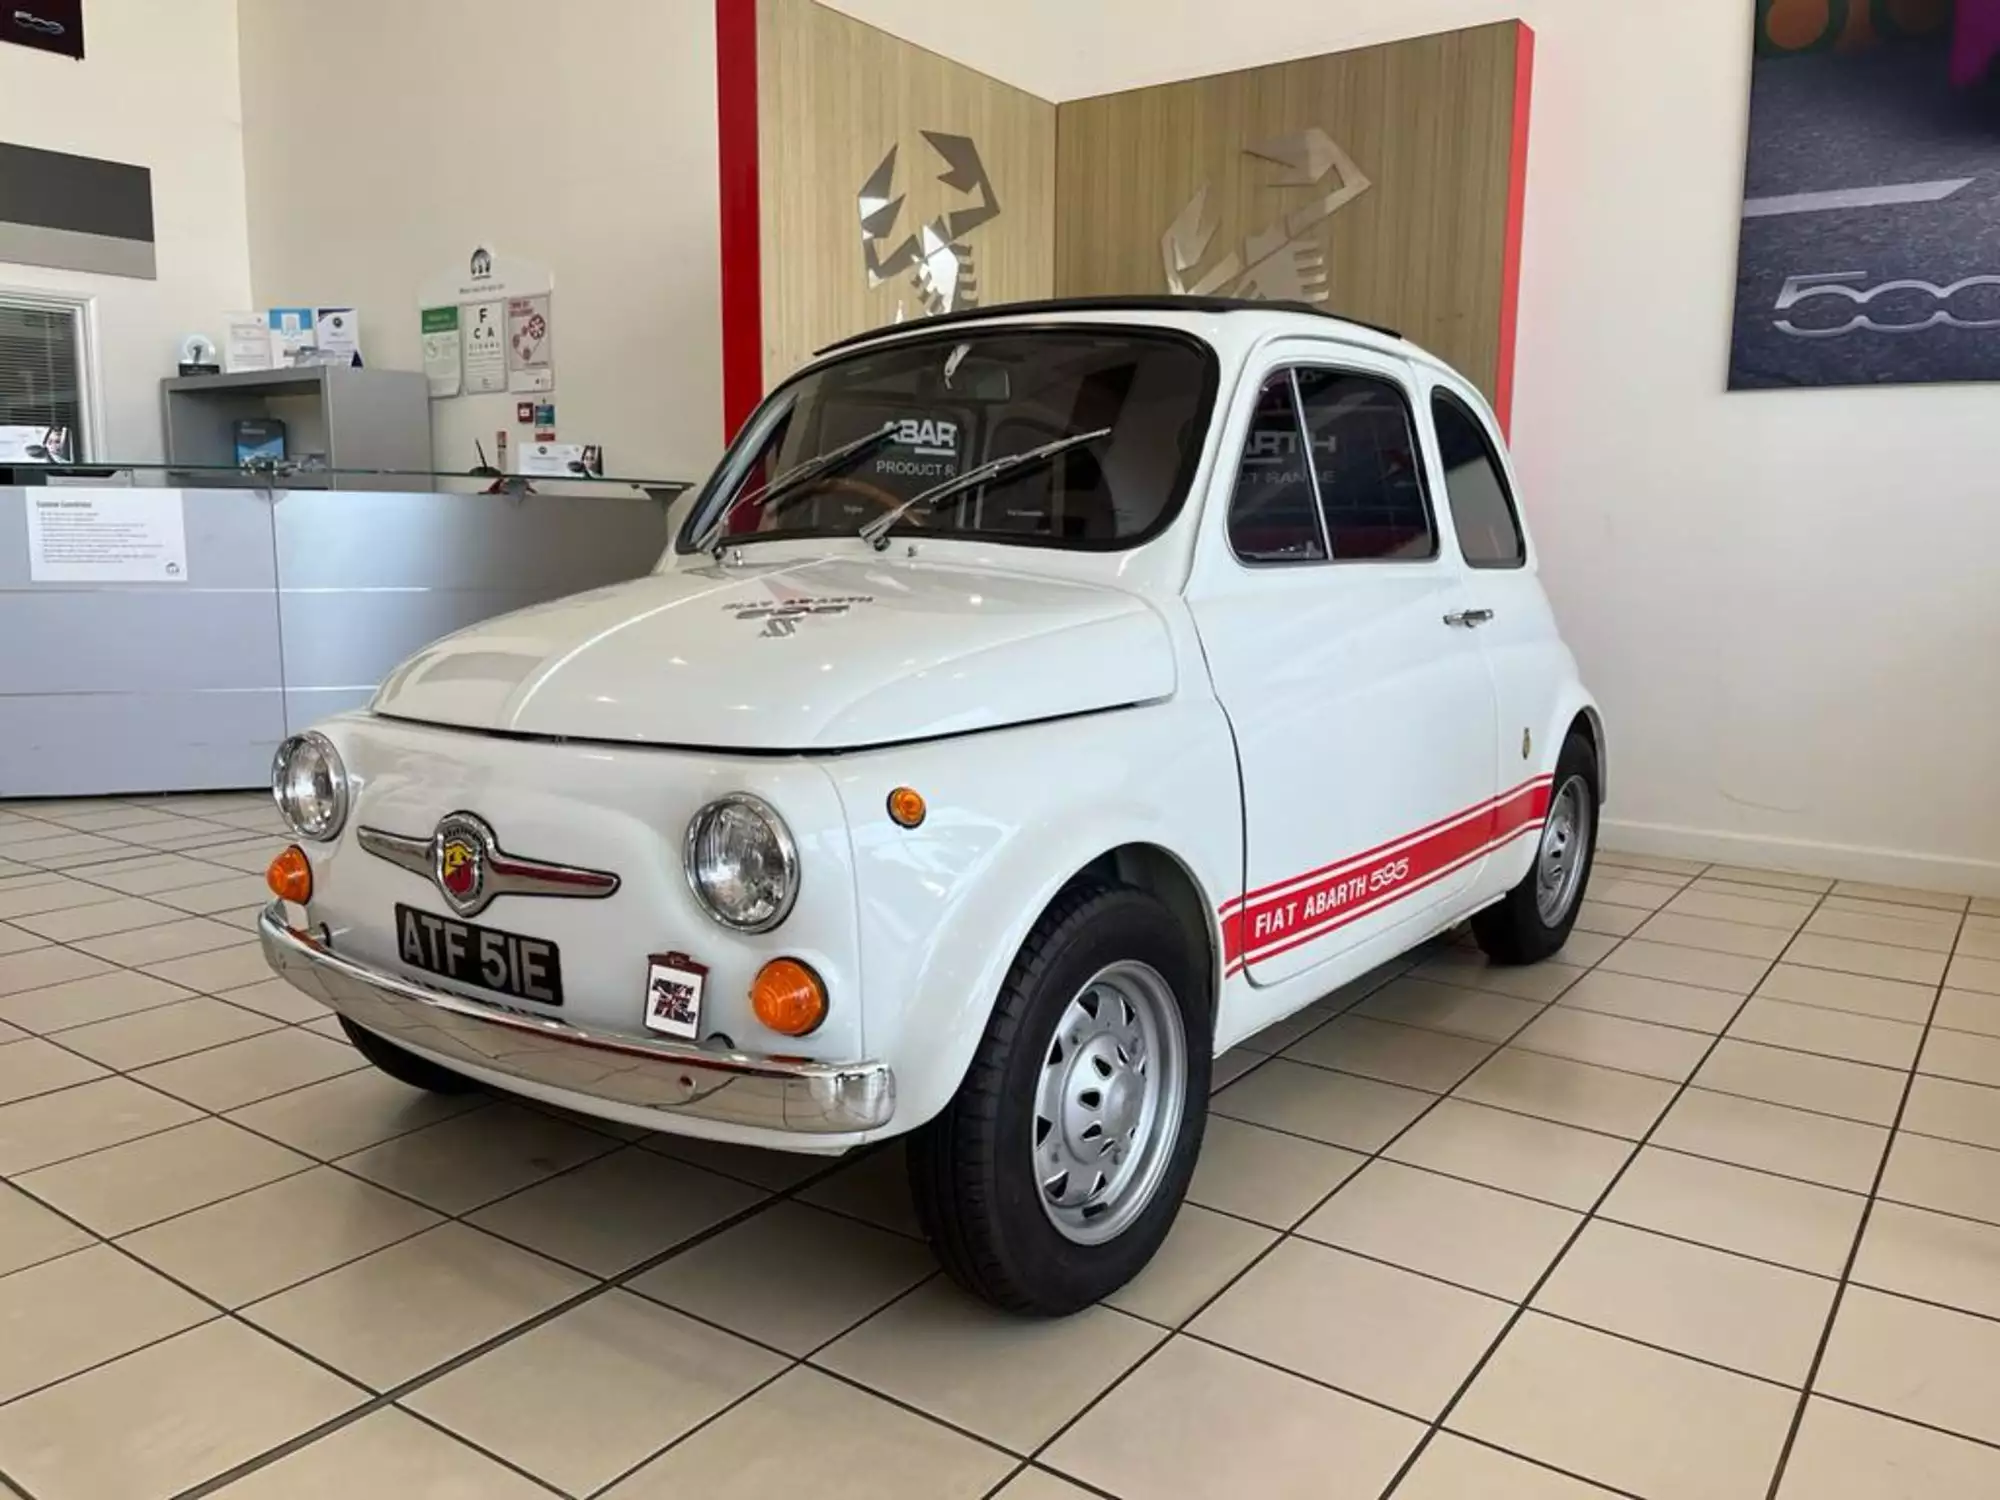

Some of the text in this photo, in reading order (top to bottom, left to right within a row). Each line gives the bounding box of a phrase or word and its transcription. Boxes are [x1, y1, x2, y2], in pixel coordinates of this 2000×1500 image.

[1773, 270, 2000, 338] 500
[479, 307, 488, 323] F
[473, 327, 495, 339] C A
[876, 459, 942, 477] PRODUCT
[1265, 470, 1336, 484] RANE
[1255, 857, 1410, 938] FIAT ABARTH 595
[403, 909, 468, 976] ATF
